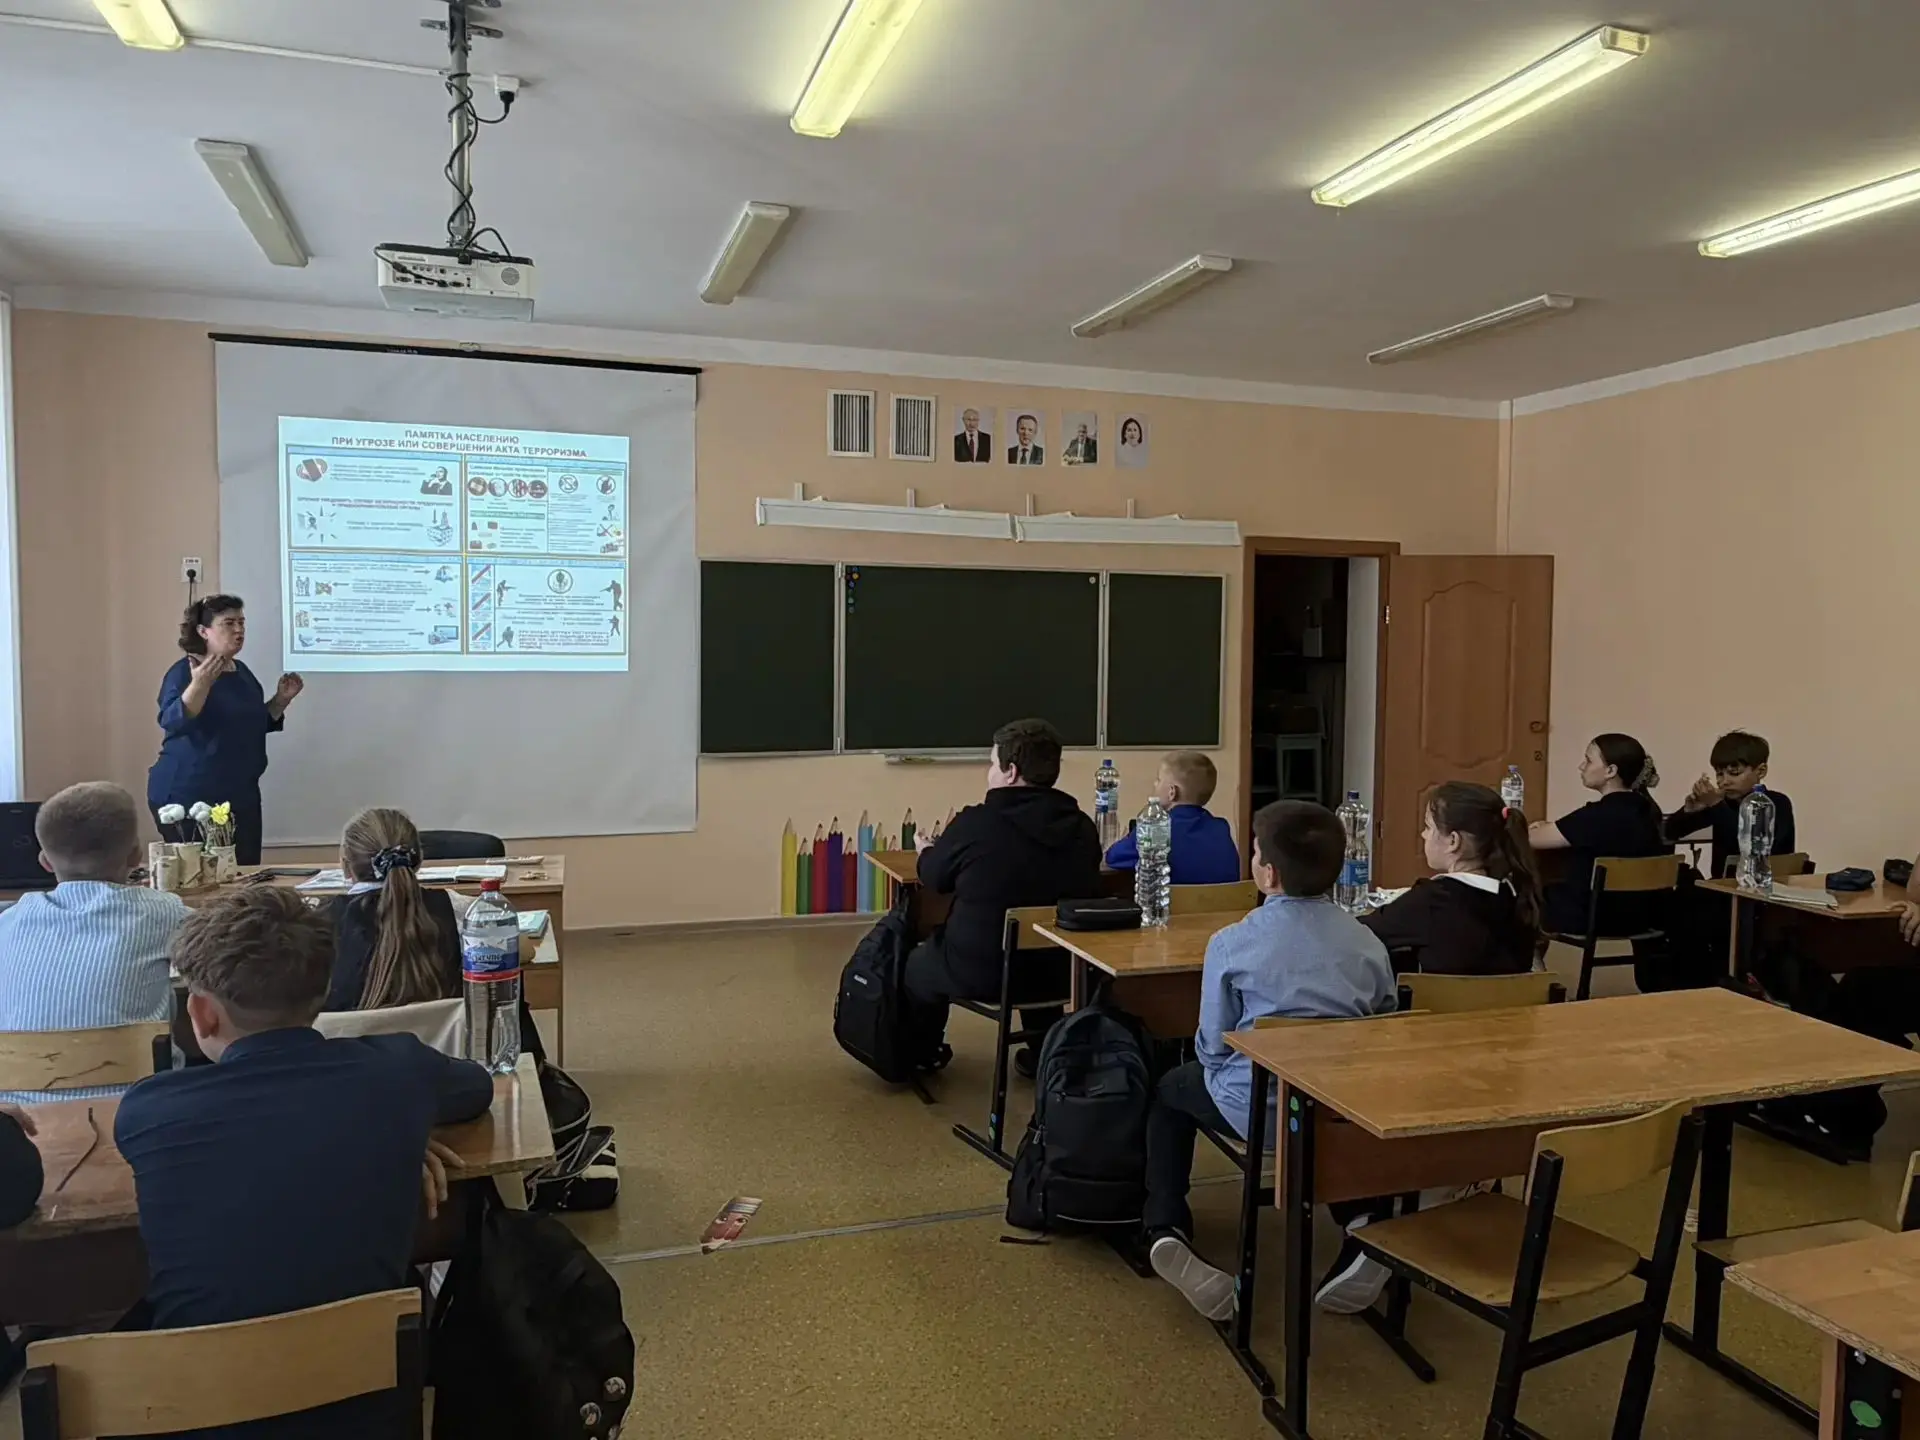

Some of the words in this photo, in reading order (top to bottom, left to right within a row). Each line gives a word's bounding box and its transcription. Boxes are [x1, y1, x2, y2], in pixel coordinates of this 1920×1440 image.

[405, 430, 452, 441] ПАМЯТКА
[456, 433, 519, 444] НАСЕЛЕНИЮ
[332, 437, 353, 446] ПРИ
[356, 438, 395, 448] УГРОЗЕ
[398, 440, 419, 449] ИЛИ
[422, 441, 493, 452] СОВЕРШЕНИИ
[495, 445, 520, 454] АКТА
[523, 446, 587, 457] ТЕРРОРИЗМА
